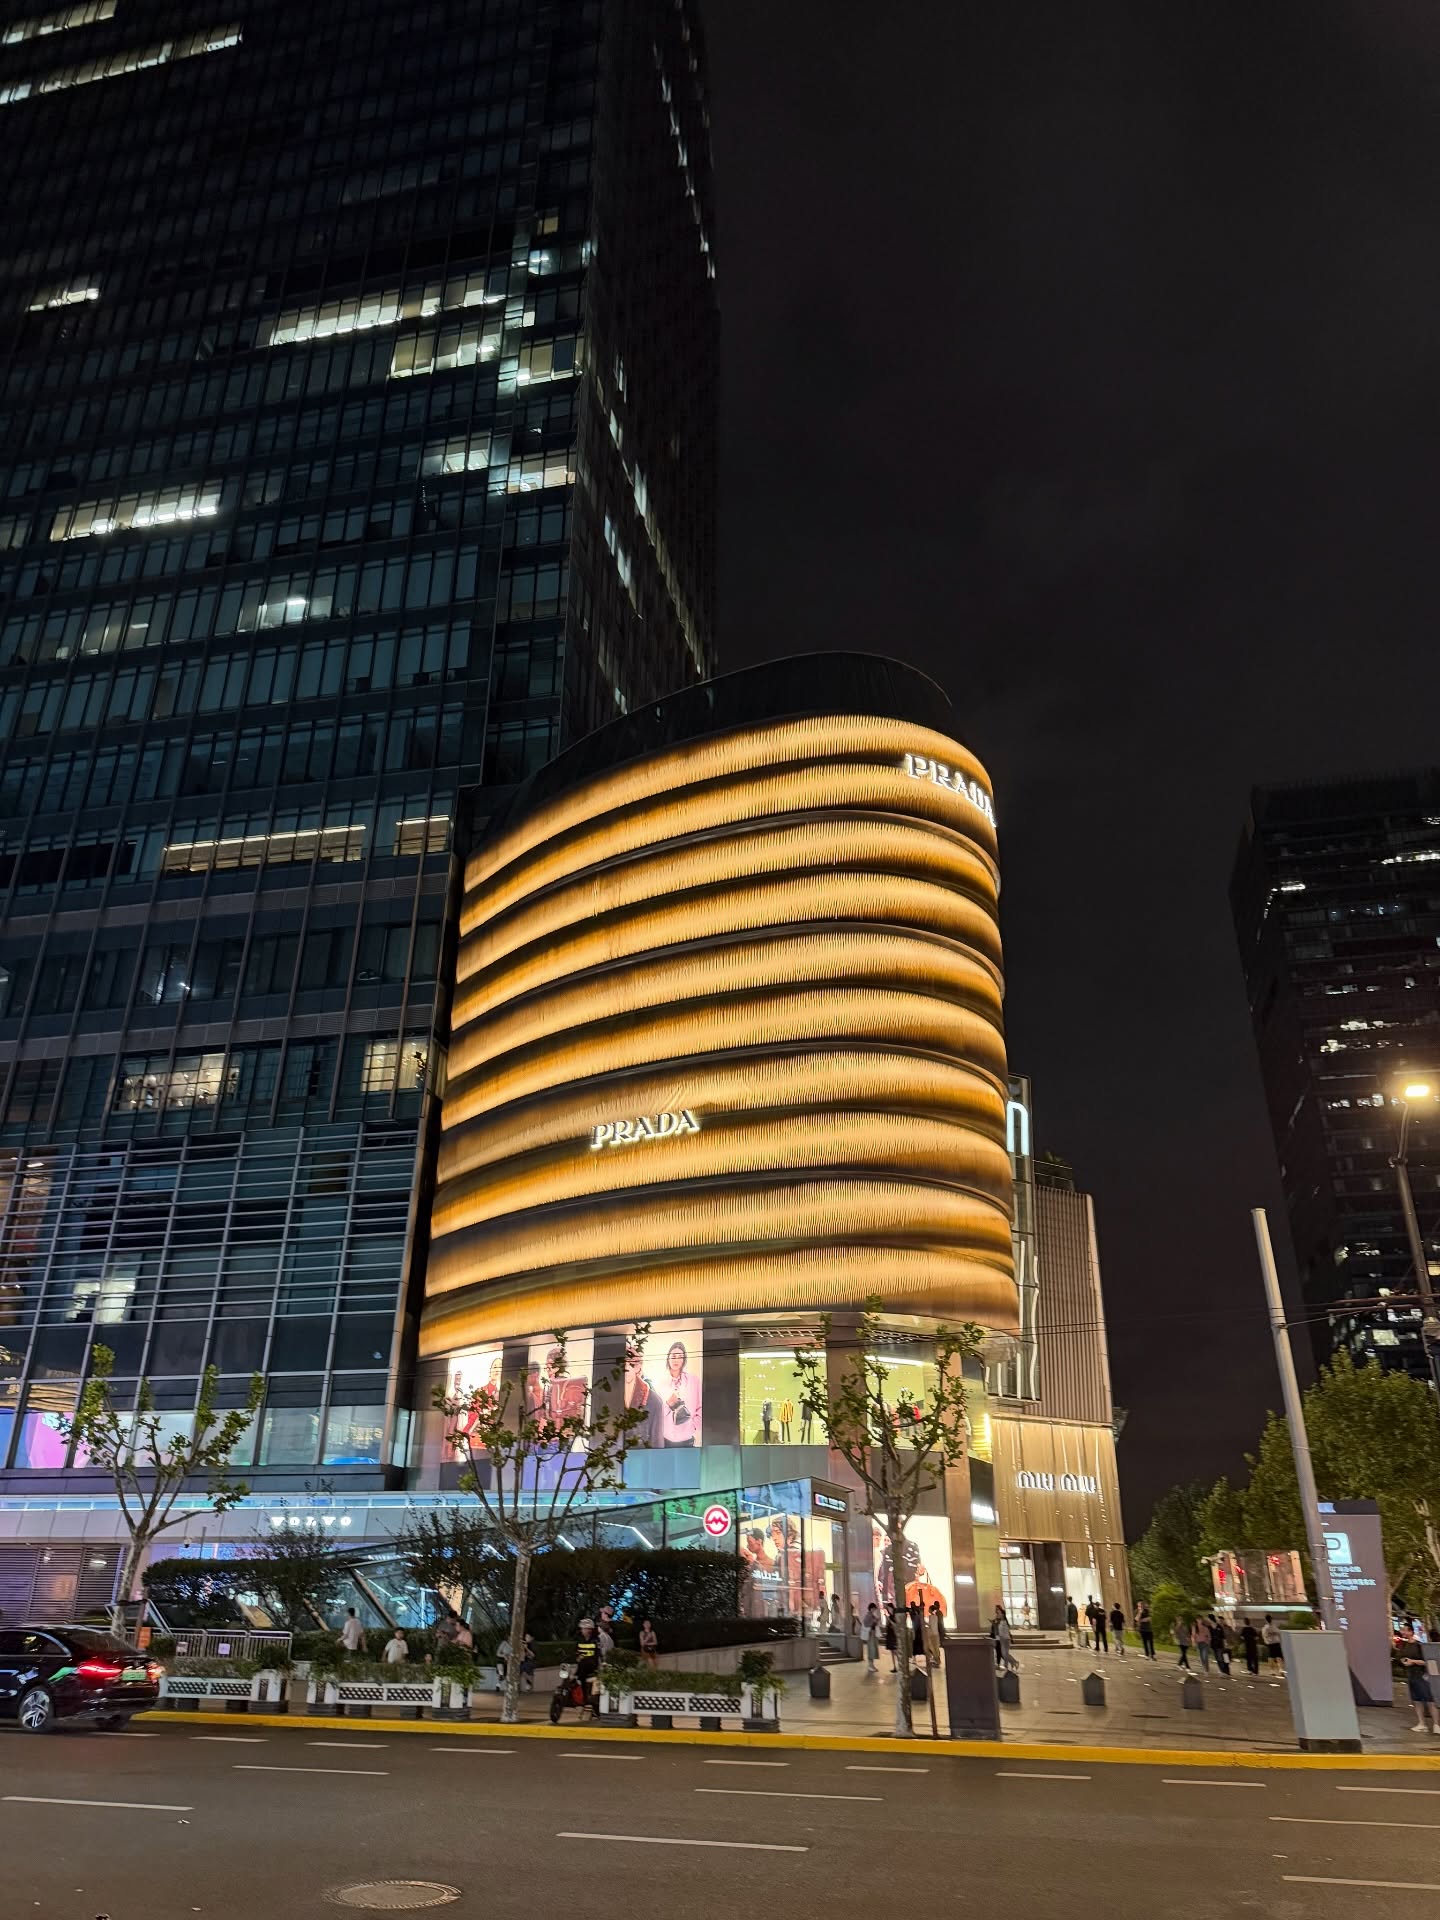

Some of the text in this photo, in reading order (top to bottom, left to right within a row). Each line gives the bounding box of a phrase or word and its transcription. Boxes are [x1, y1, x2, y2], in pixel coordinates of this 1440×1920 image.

[904, 753, 996, 827] PRADA
[590, 1109, 700, 1148] PRADA
[1017, 1470, 1054, 1491] miu
[271, 1516, 352, 1527] VOLVO
